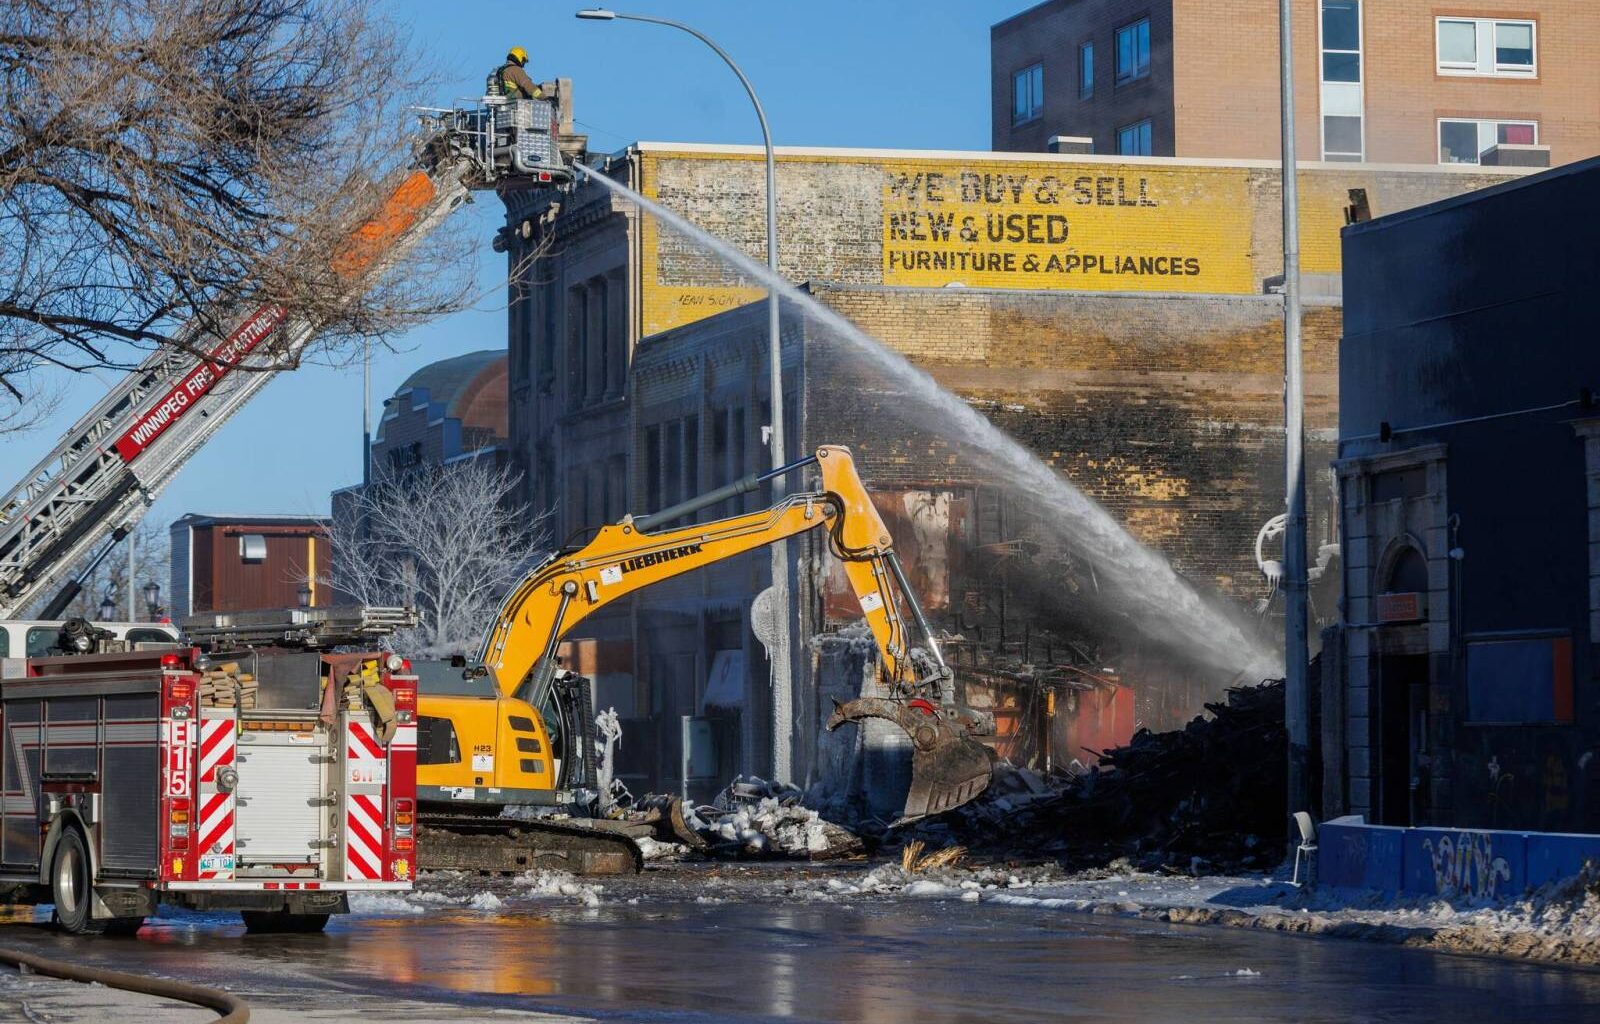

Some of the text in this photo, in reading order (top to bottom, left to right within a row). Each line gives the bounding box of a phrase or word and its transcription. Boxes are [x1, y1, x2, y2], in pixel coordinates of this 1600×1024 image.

[886, 172, 1160, 207] WE BUY & SELL
[889, 211, 1069, 245] NEW & USED
[889, 250, 1200, 276] FURNITURE & APPLIANCES
[131, 391, 188, 445] WINNIPEG
[185, 366, 215, 397] FIRE
[620, 542, 703, 574] LIEBHERR
